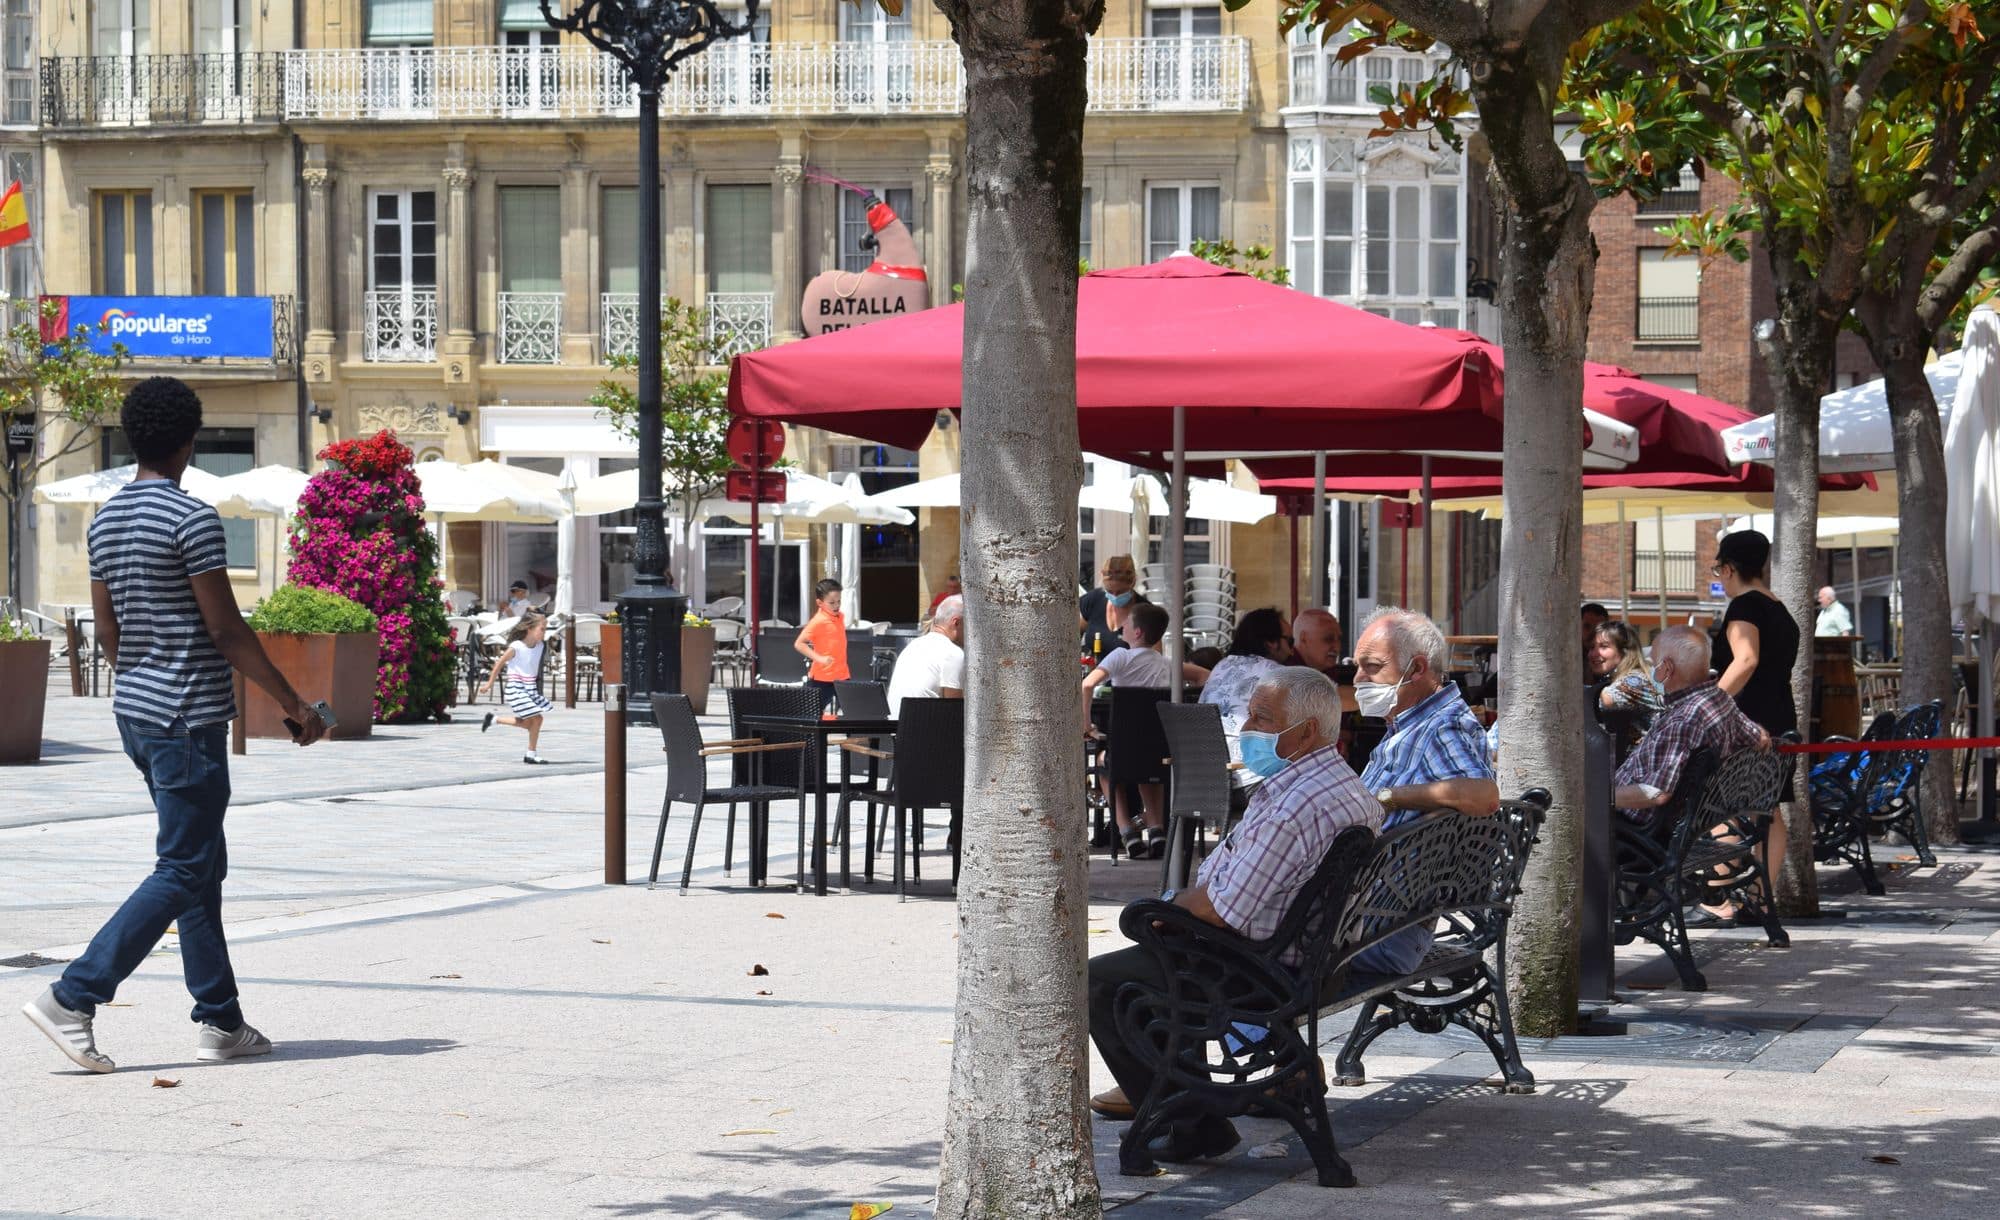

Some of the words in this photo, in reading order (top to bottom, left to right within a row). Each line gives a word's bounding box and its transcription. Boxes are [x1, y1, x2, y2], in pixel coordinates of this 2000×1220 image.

[820, 296, 906, 315] BATALLA
[112, 313, 208, 337] populares
[171, 334, 185, 344] de
[187, 334, 212, 344] Haro
